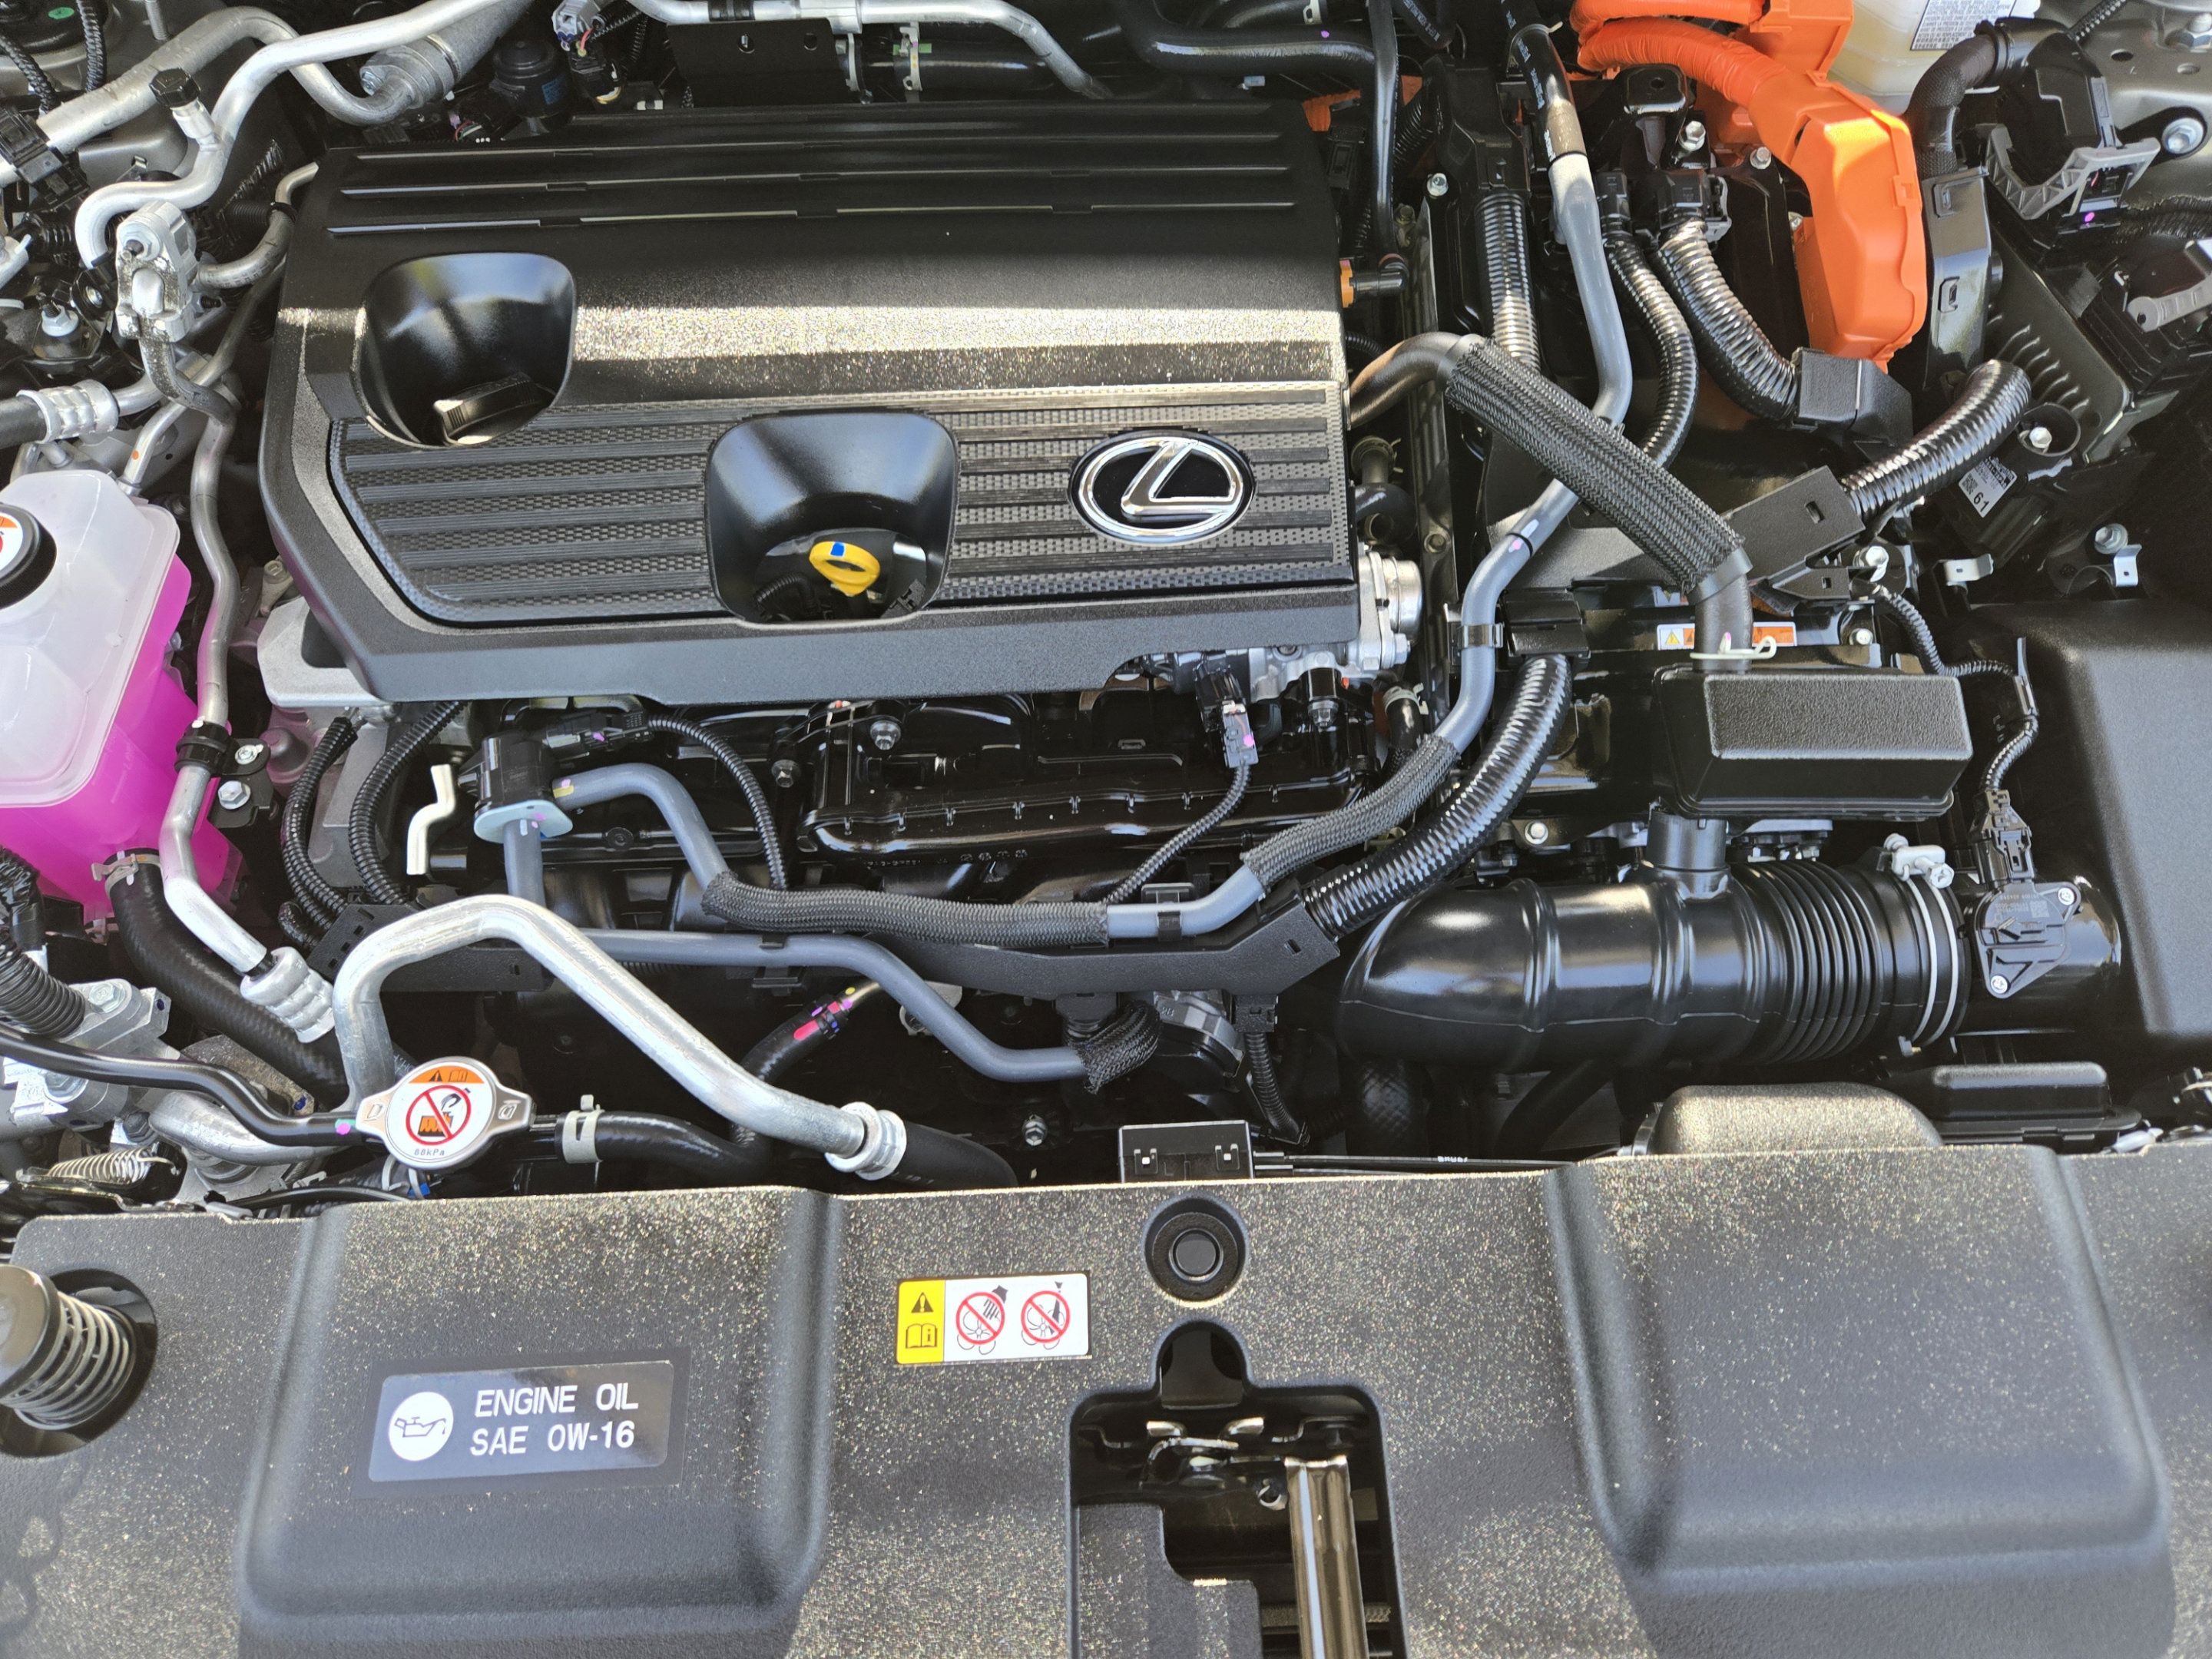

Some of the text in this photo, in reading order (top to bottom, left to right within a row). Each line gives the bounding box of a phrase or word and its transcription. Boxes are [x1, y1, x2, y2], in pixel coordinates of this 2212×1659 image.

[1973, 491, 1990, 512] 61
[474, 1382, 639, 1418] ENGINE OIL
[469, 1420, 636, 1456] SAE 0W-16
